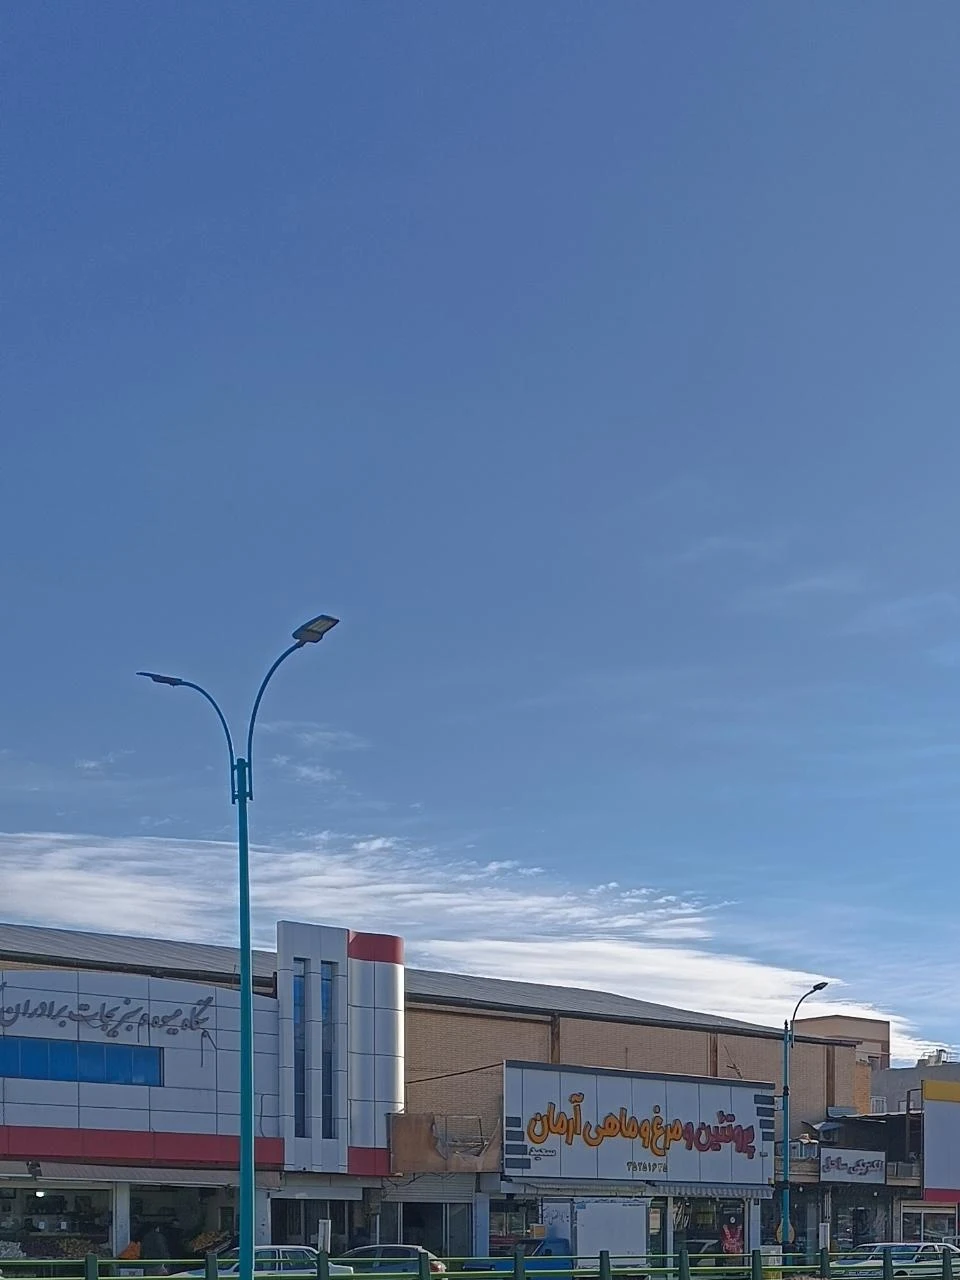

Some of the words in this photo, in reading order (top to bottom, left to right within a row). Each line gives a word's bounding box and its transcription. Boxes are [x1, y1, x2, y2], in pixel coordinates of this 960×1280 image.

[527, 1092, 584, 1145] آرمان
[583, 1106, 640, 1147] ماهی
[639, 1117, 651, 1150] و
[650, 1104, 683, 1157] مرغ
[682, 1120, 695, 1151] و
